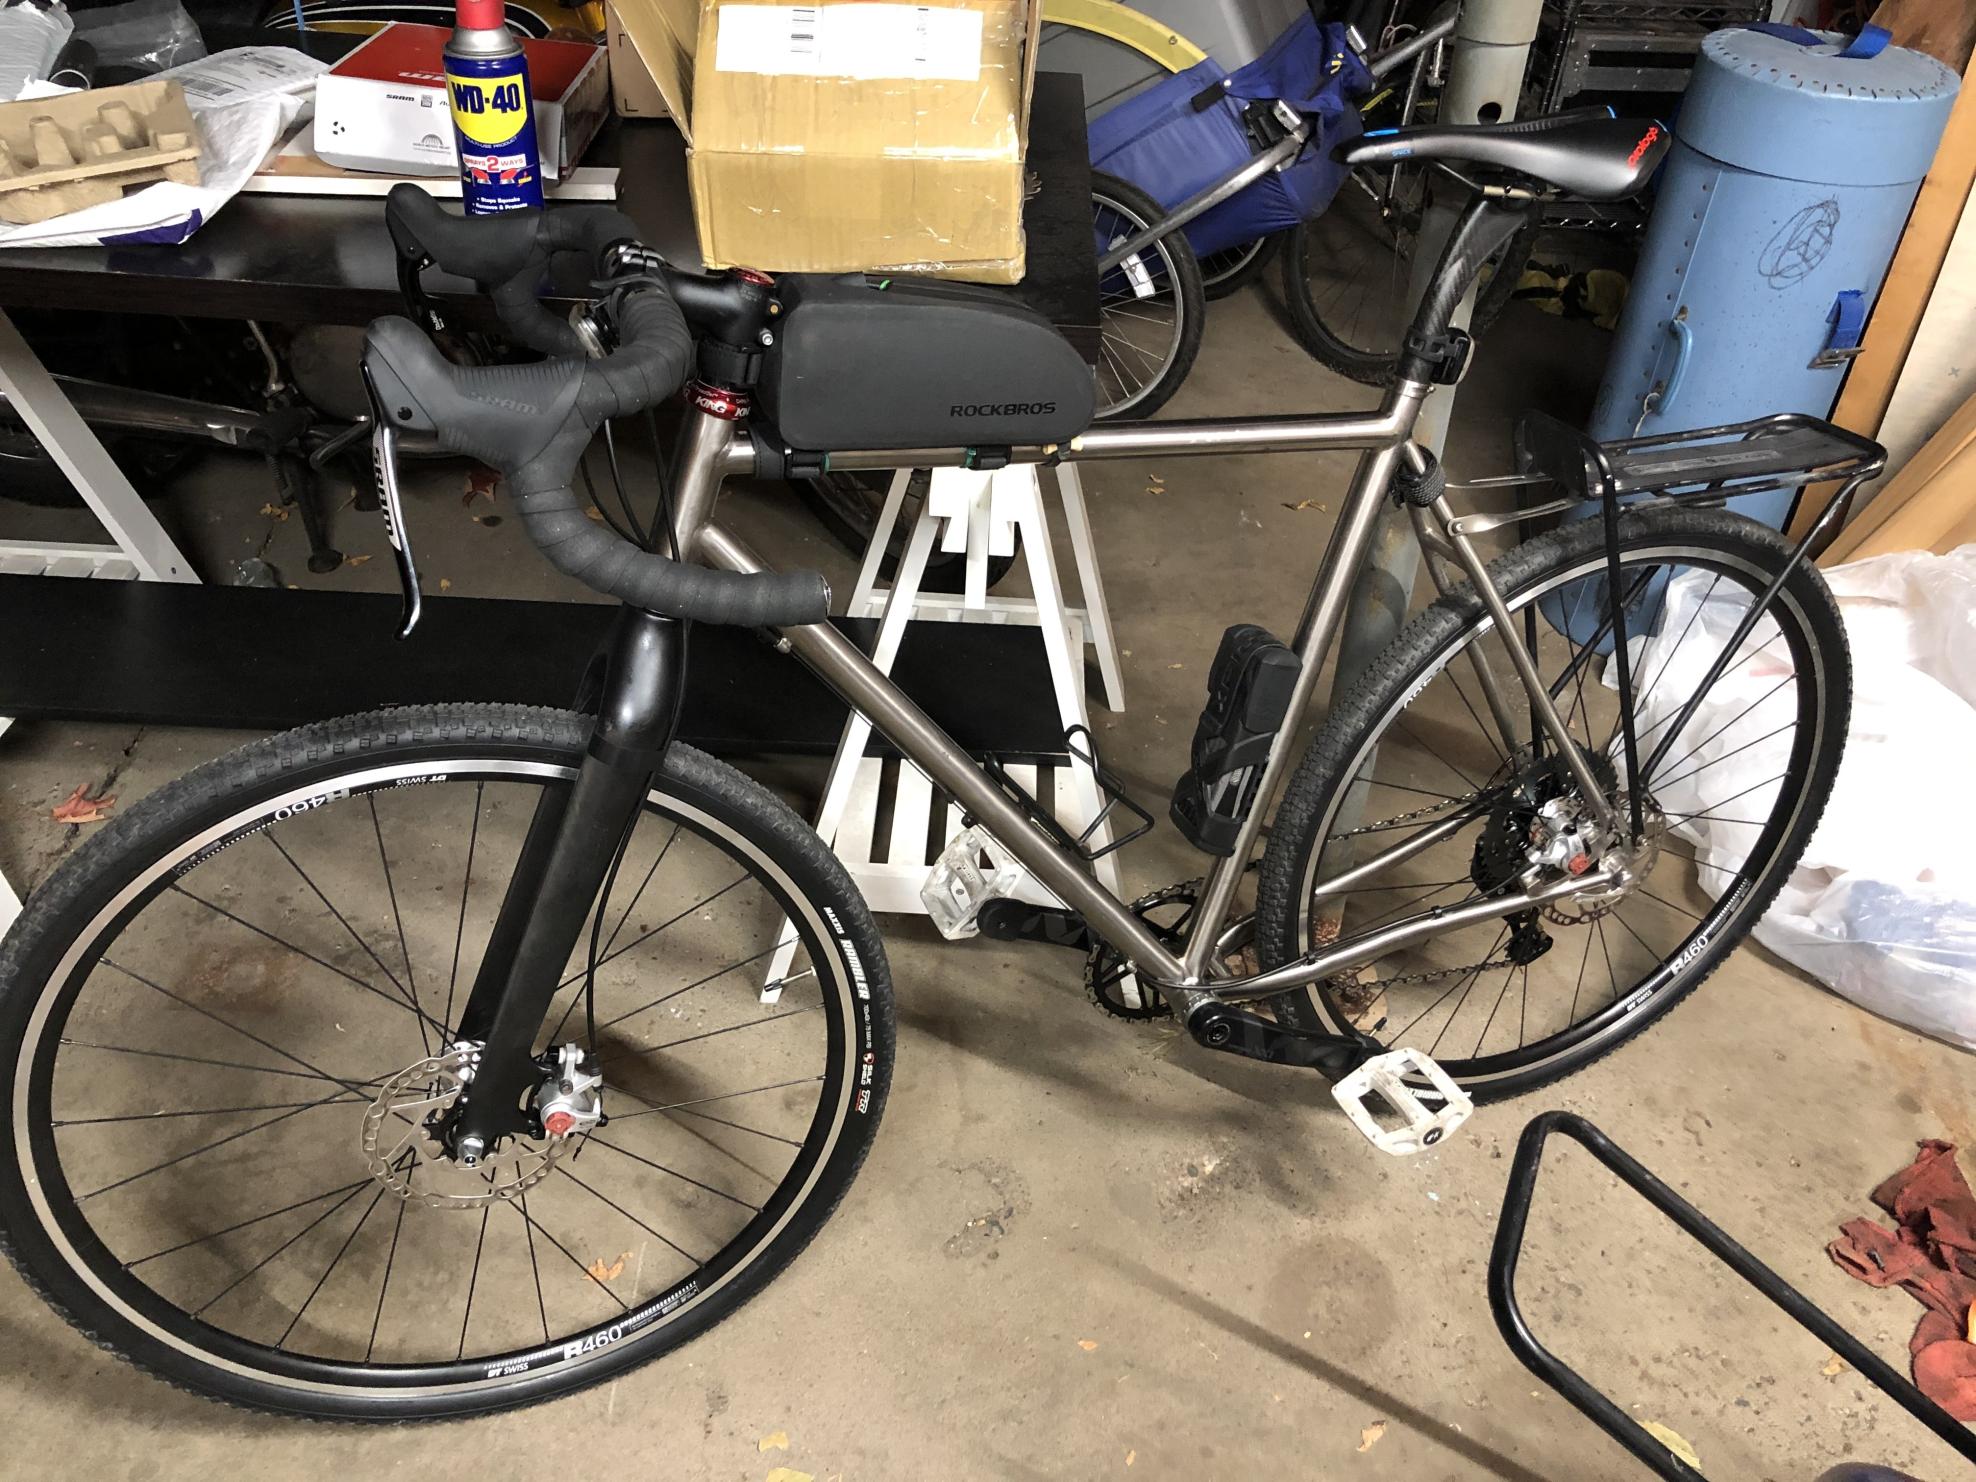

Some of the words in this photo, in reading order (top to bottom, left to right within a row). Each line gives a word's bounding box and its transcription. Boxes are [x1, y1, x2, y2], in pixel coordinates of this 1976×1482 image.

[451, 81, 521, 115] WD-40
[486, 156, 500, 172] 2
[500, 157, 524, 167] WAYS
[695, 395, 728, 414] KING
[950, 401, 1057, 417] ROCKBROS
[396, 774, 427, 786] SWISS
[823, 906, 845, 935] MAXXIS
[839, 938, 871, 1000] RAMBLER
[1669, 935, 1708, 976] R460
[563, 1325, 623, 1360] R460
[503, 1362, 529, 1375] SWISS
